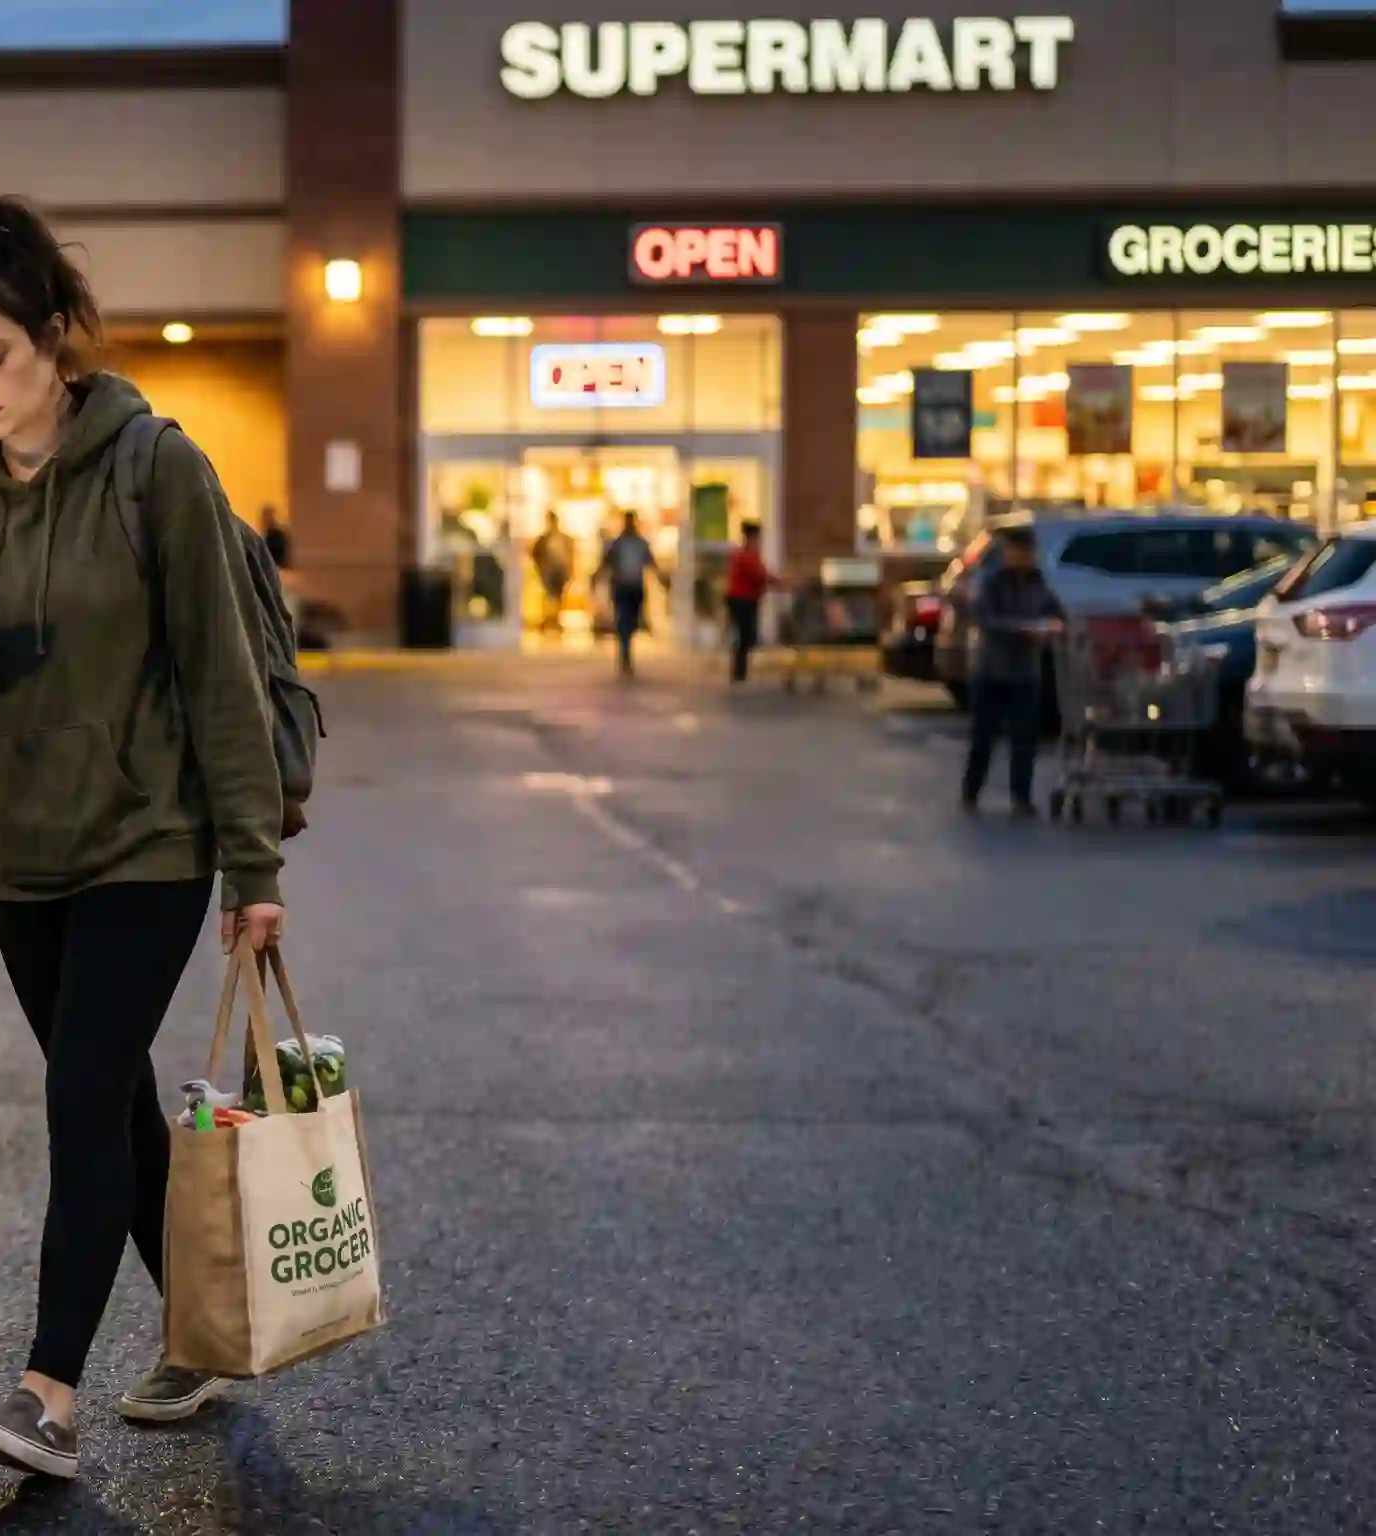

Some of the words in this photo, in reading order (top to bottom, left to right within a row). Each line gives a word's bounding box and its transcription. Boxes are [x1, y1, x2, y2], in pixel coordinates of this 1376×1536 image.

[500, 16, 1075, 98] SUPERMART
[634, 228, 777, 279] OPEN
[1108, 224, 1376, 275] GROCERIE
[268, 1197, 366, 1249] ORGANIC
[270, 1227, 371, 1284] GROCER
